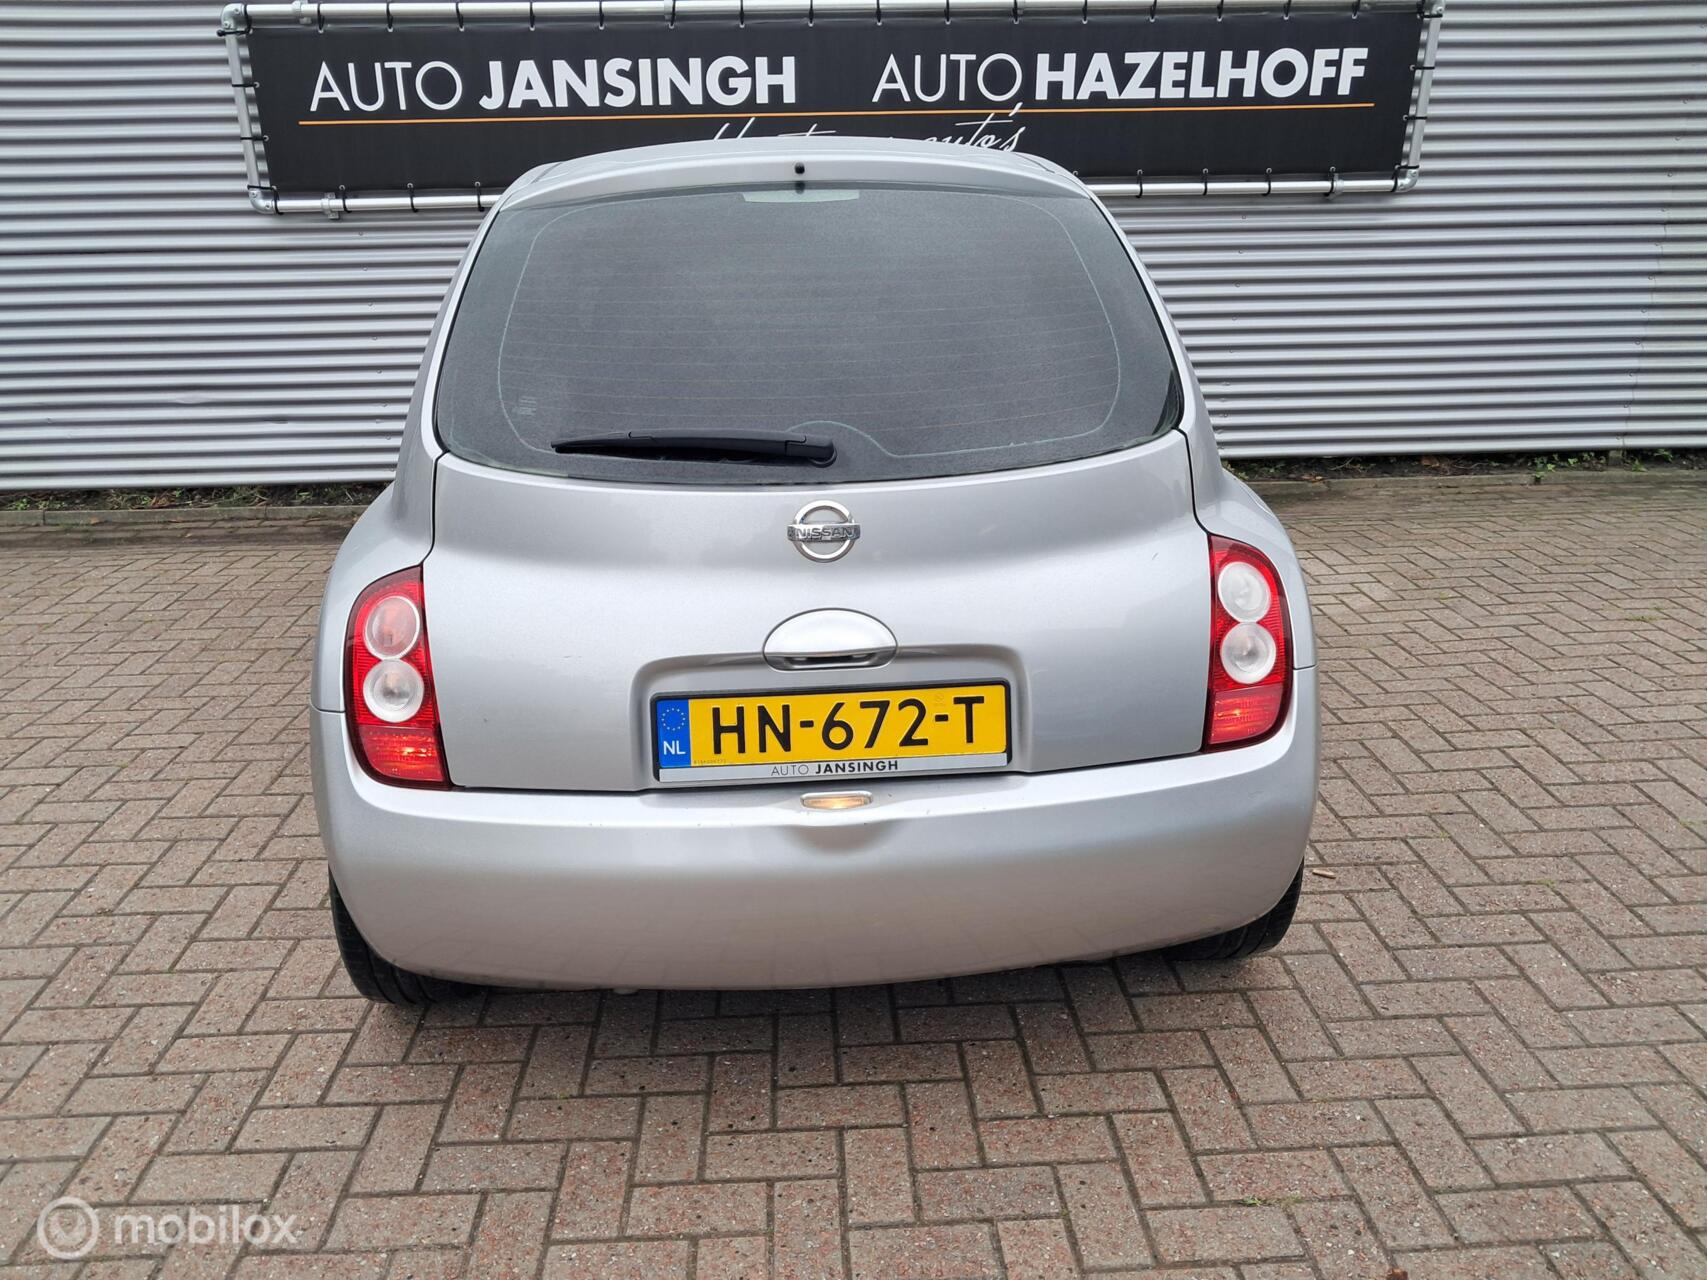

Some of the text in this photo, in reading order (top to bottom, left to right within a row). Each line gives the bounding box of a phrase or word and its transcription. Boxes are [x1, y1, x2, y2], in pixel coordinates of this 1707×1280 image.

[310, 55, 797, 112] AUTO JANSINGH
[872, 47, 1369, 103] AUTO HAZELHOFF
[796, 527, 854, 539] NISSAN
[711, 695, 985, 755] HN-672-T
[663, 740, 686, 756] NL
[770, 760, 899, 777] AUTO JANSINGH
